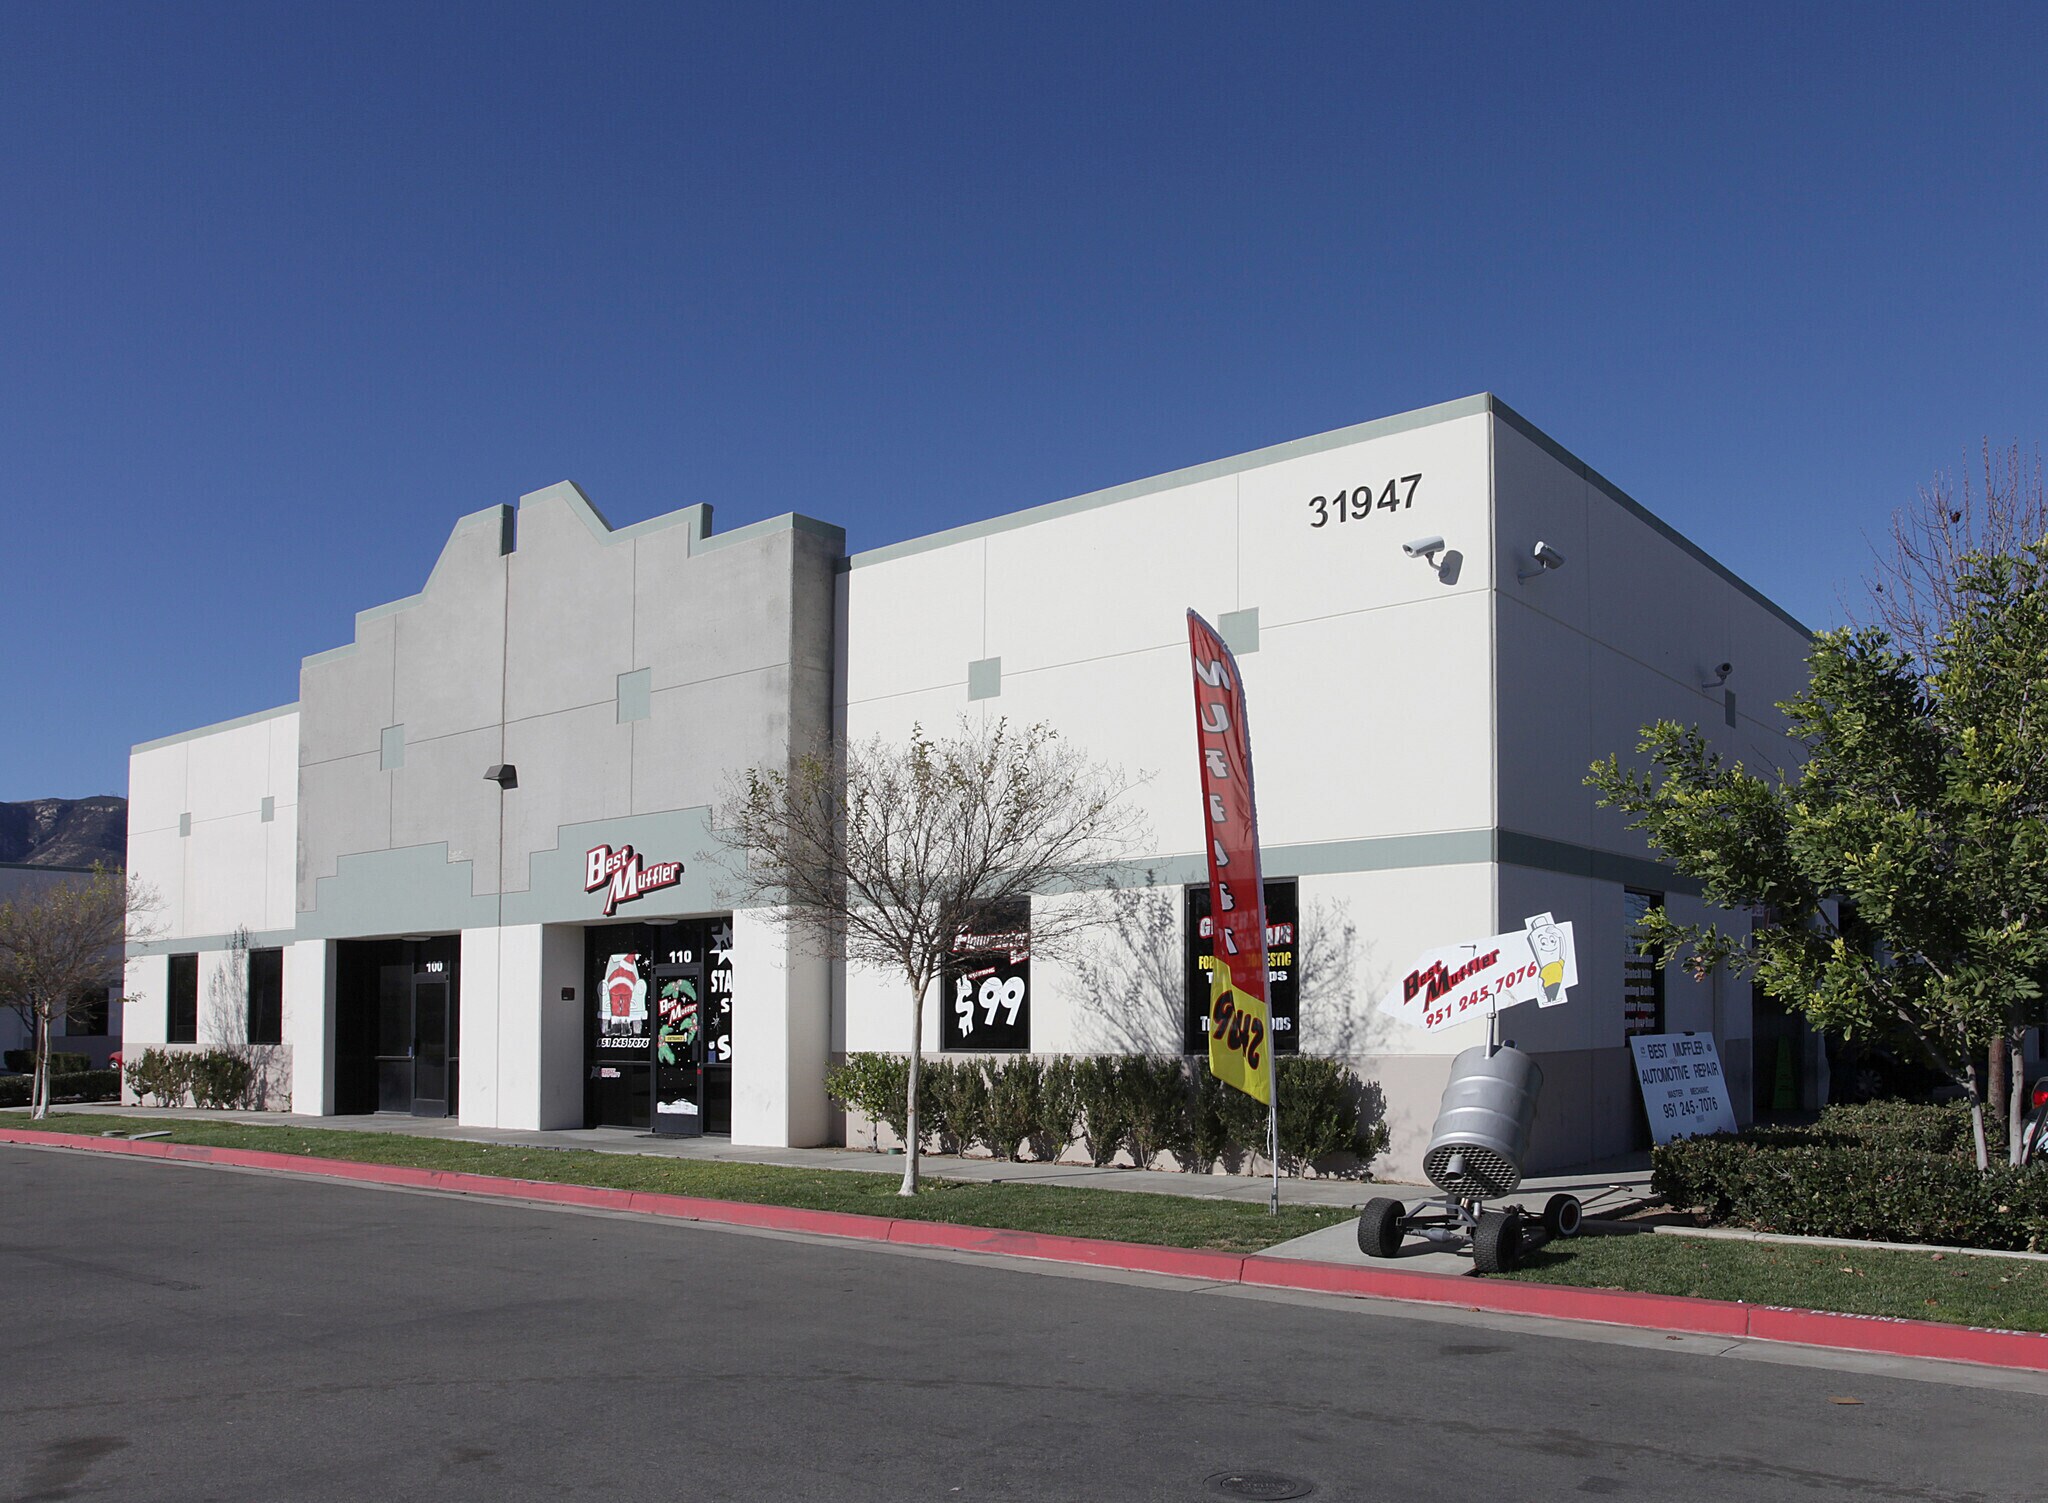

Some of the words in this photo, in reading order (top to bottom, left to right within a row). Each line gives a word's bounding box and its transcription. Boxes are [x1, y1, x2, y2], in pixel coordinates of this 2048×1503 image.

[1307, 473, 1422, 528] 31947
[584, 844, 632, 894] Best
[602, 854, 683, 916] Muffler
[1199, 907, 1268, 939] GENERA
[426, 961, 443, 973] 100
[669, 950, 692, 963] 110
[1403, 960, 1442, 1006] Best
[1423, 949, 1500, 1013] Muffler
[1425, 1003, 1452, 1029] 951
[1459, 985, 1489, 1013] 245
[1495, 961, 1537, 995] 7076
[611, 1037, 628, 1048] 245
[628, 1037, 651, 1048] 7076
[1647, 1043, 1668, 1059] BEST
[1672, 1040, 1705, 1057] MUFFLER
[1642, 1065, 1690, 1085] AUTOMOTIVE
[1692, 1061, 1719, 1078] REPAIR
[1663, 1102, 1678, 1119] 951
